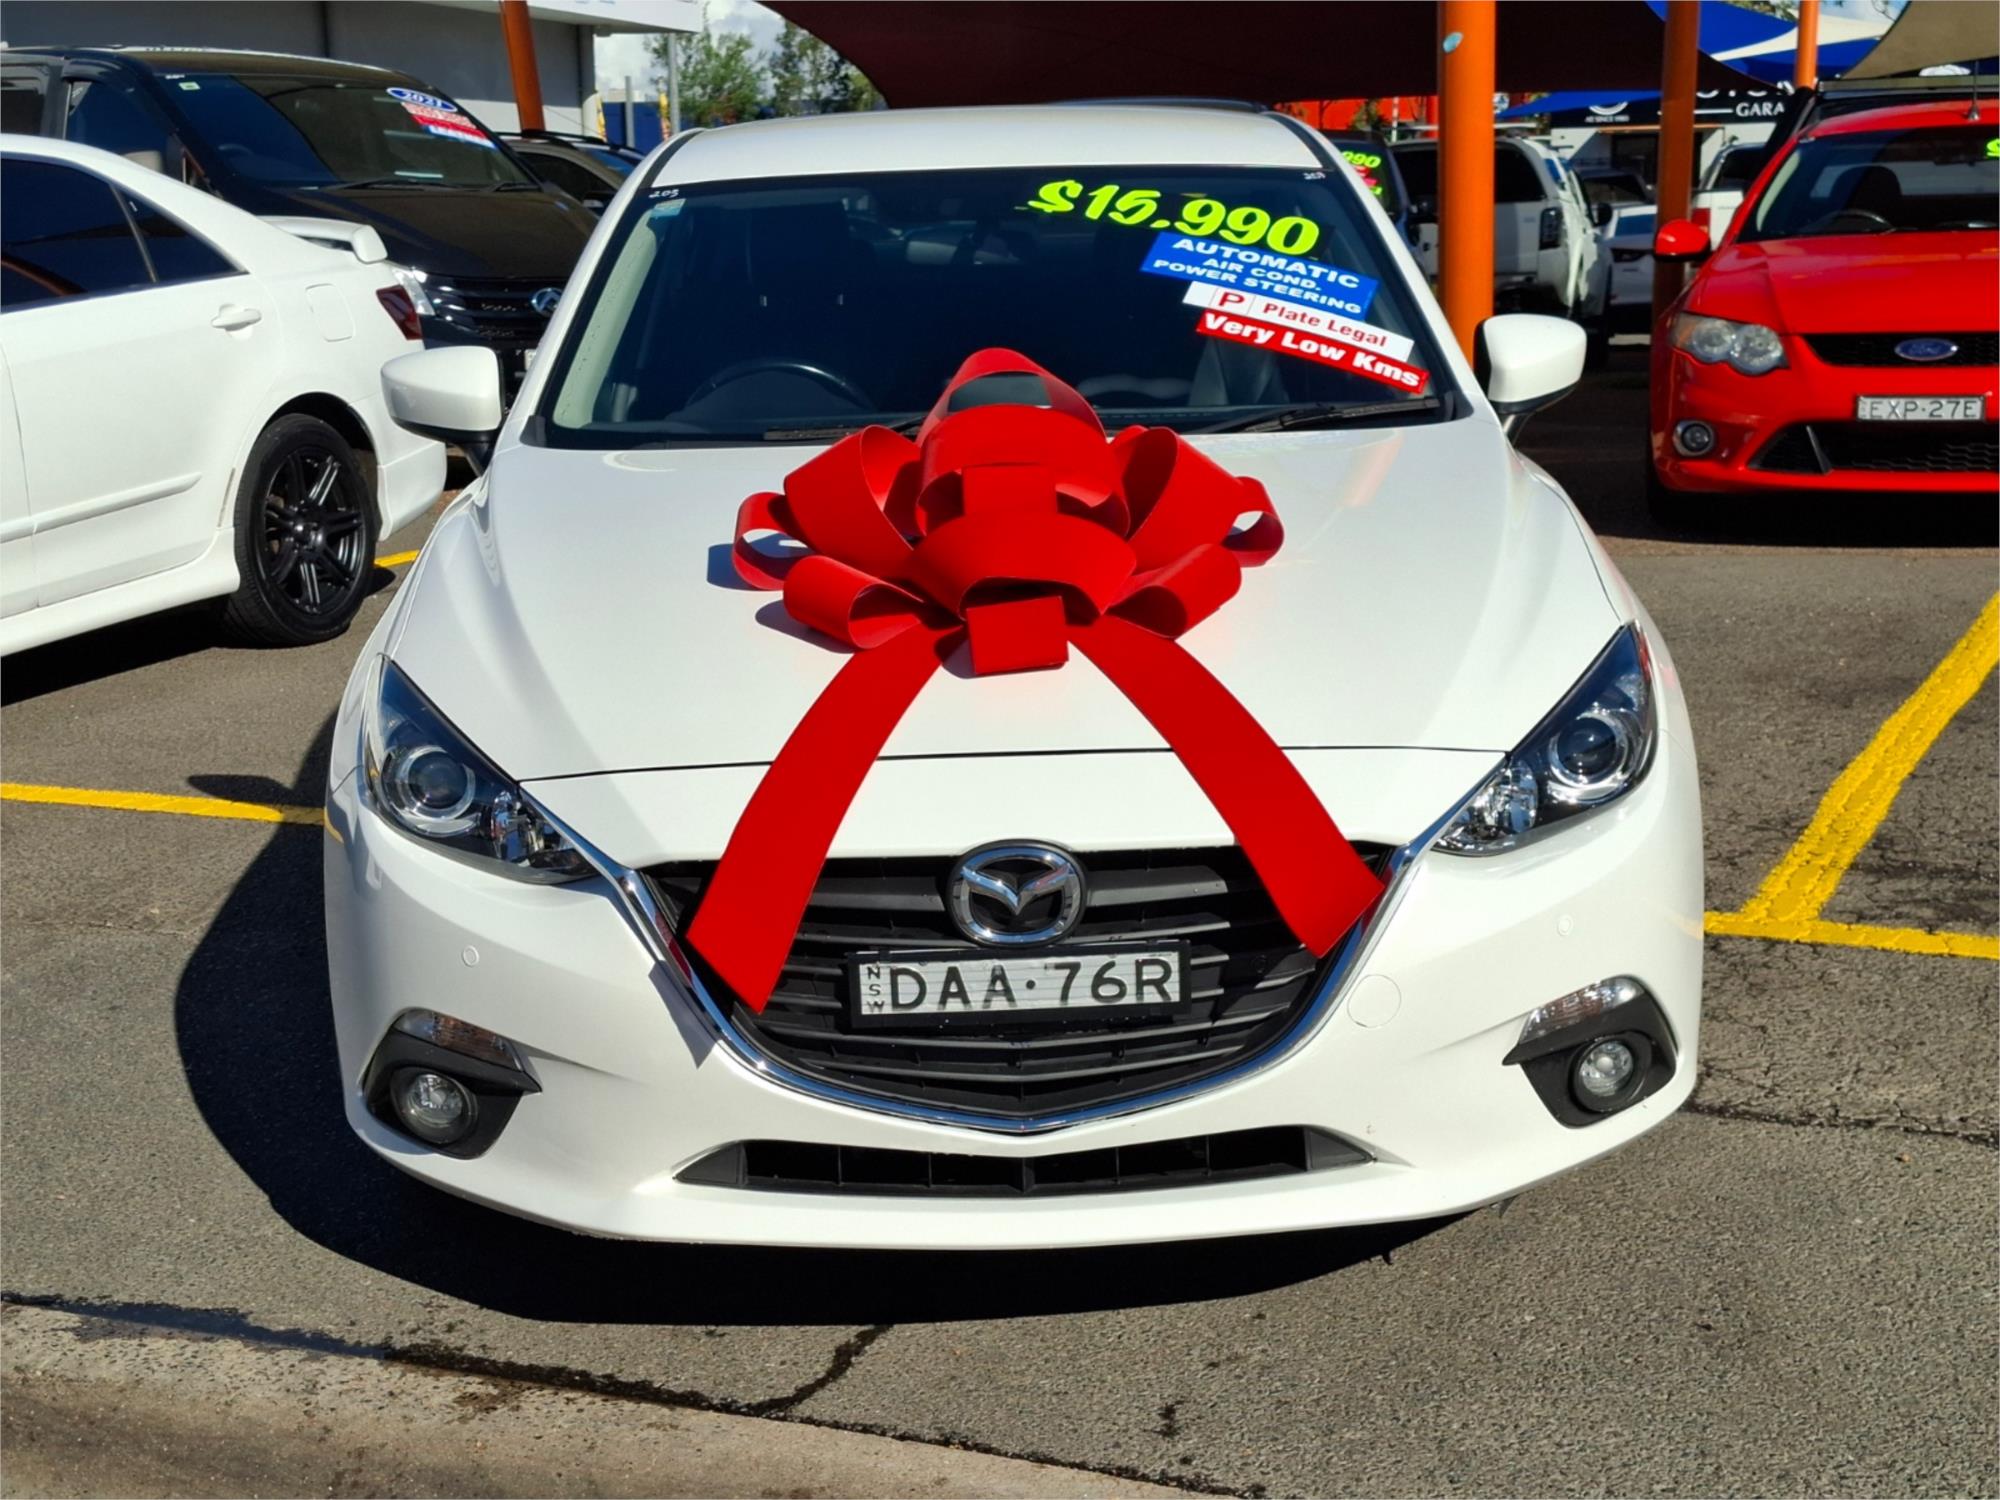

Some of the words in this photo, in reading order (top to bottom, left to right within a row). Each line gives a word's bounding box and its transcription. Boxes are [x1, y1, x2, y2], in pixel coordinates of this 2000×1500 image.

[1153, 259, 1237, 283] POWER
[1243, 278, 1363, 314] STEERING
[1173, 238, 1360, 289] AUTOMATIC
[1202, 257, 1244, 273] AIR
[1250, 268, 1322, 291] COND.
[1218, 291, 1246, 307] P
[1263, 303, 1321, 327] Plate
[1327, 319, 1388, 347] Legal
[1204, 313, 1276, 344] Very
[1281, 332, 1346, 361] Low
[1352, 352, 1421, 387] Kms
